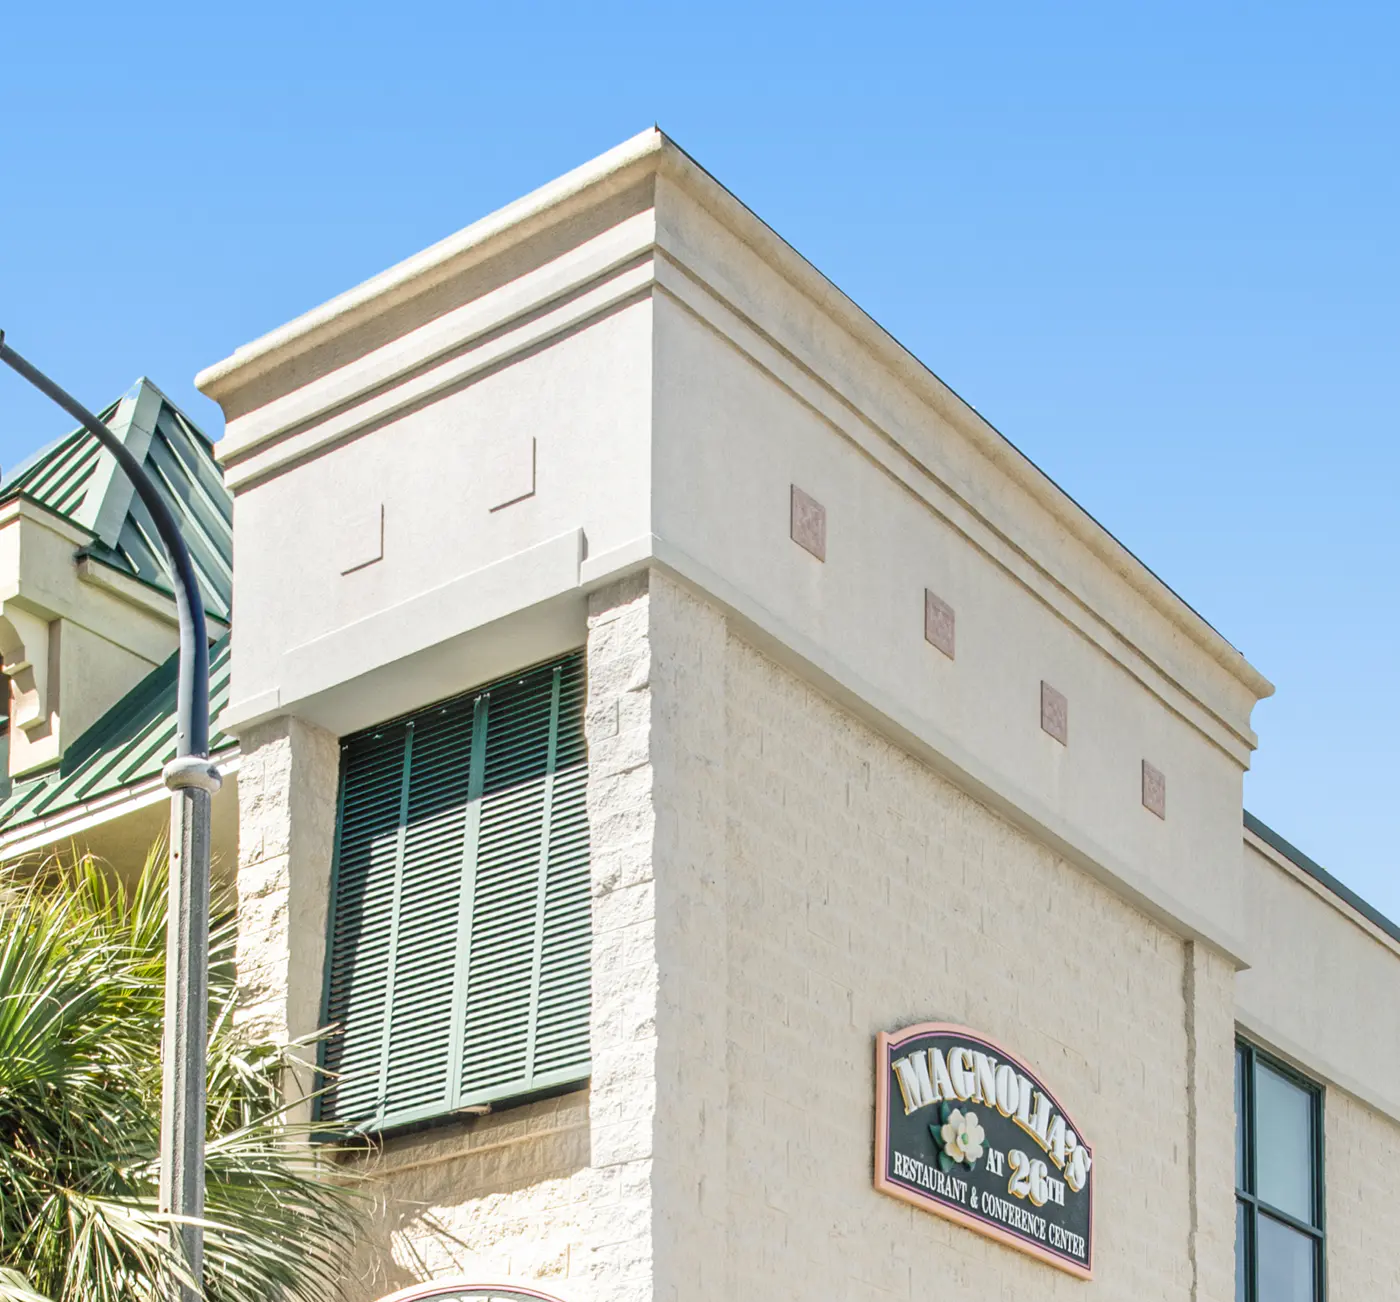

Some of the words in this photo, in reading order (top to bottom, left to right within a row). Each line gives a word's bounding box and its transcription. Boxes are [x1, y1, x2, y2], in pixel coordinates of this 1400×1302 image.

[892, 1047, 1092, 1192] MAGNOLIA'S
[986, 1148, 1004, 1177] AT
[894, 1151, 967, 1204] RESTAURANT
[970, 1186, 978, 1209] &
[981, 1191, 1046, 1240] CONFERENCE
[1049, 1222, 1085, 1258] CENTER
